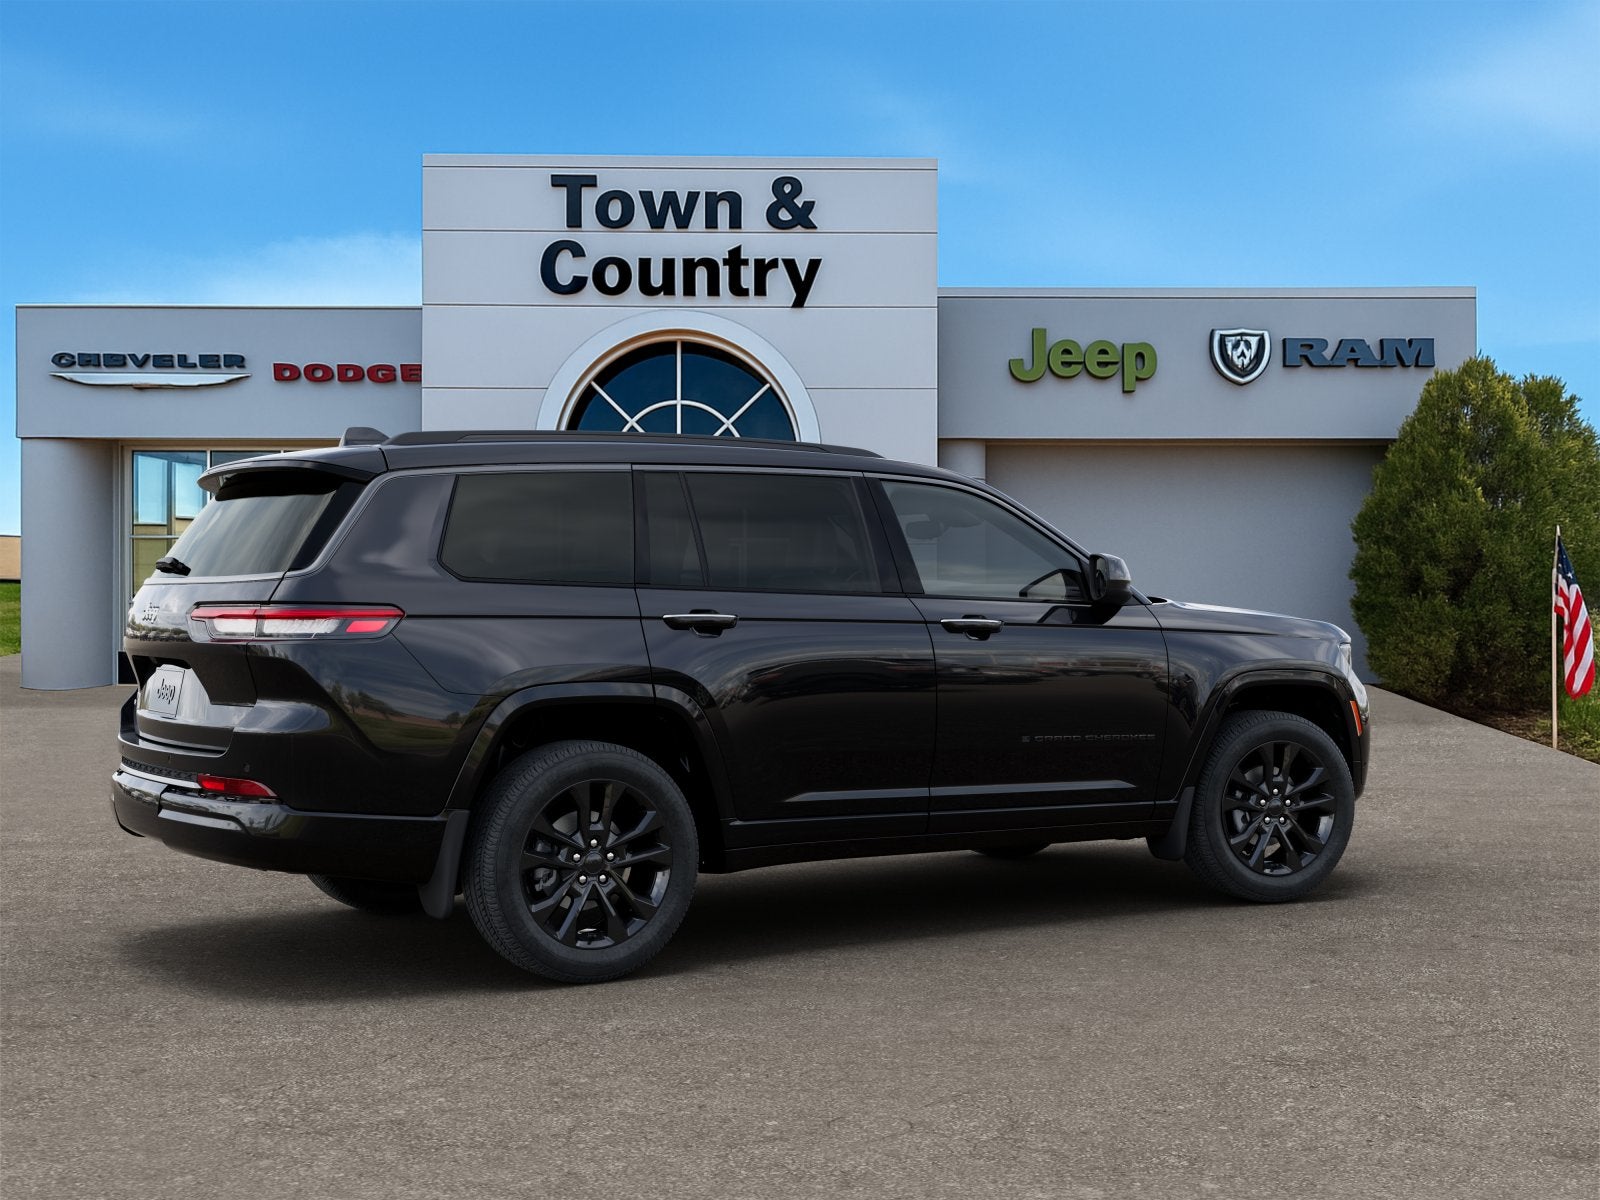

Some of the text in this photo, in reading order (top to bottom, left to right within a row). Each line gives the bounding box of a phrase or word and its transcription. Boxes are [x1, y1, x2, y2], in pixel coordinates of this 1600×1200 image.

[550, 174, 818, 230] Town &
[540, 239, 822, 308] Country
[272, 362, 422, 383] DODGE
[1009, 328, 1157, 393] Jeep
[1283, 337, 1435, 368] RAM
